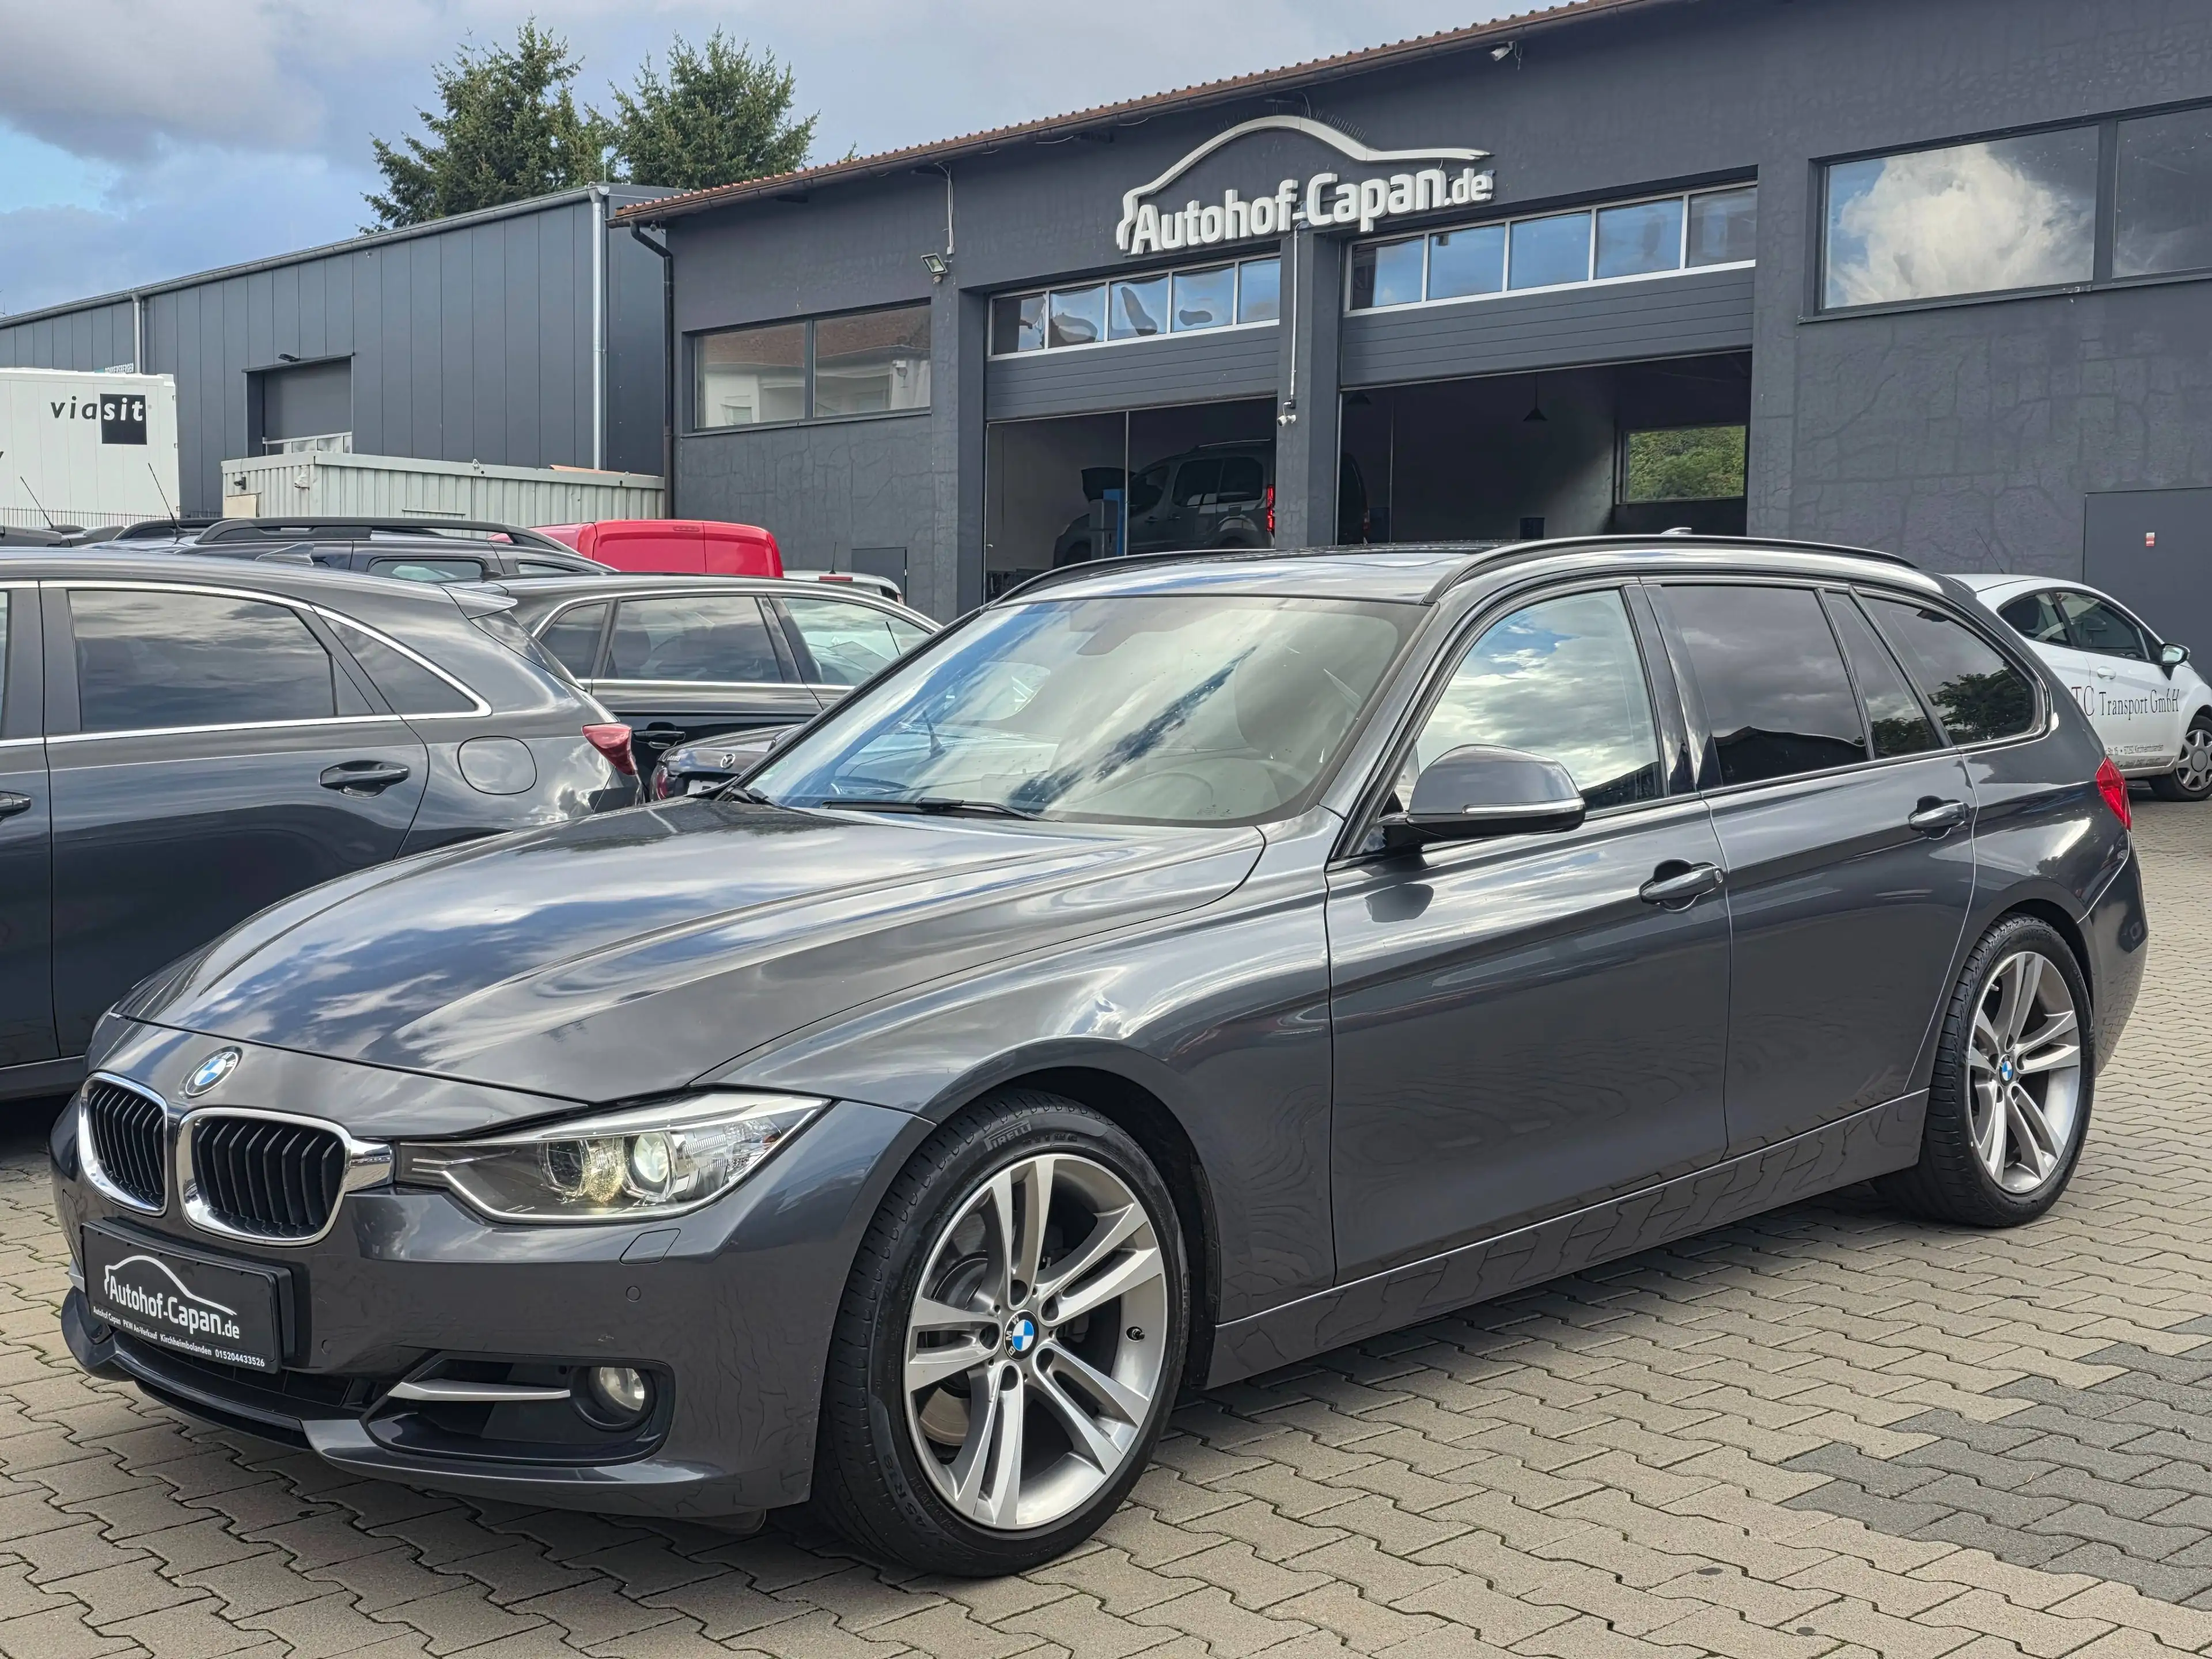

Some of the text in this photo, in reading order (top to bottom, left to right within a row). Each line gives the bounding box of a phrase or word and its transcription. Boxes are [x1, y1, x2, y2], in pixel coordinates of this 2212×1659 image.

[1131, 168, 1494, 255] Autohof-Capan.de
[51, 396, 143, 421] viasit
[2099, 691, 2147, 720] Transport
[2150, 688, 2180, 713] GmbH
[984, 1120, 1032, 1152] PIRELLI
[109, 1275, 240, 1339] Autohof-Capan.de
[93, 1306, 265, 1367] Autohof Capan PKW An-Verkauf Kirchheimbolanden 015204433526
[1006, 1314, 1020, 1356] BMW
